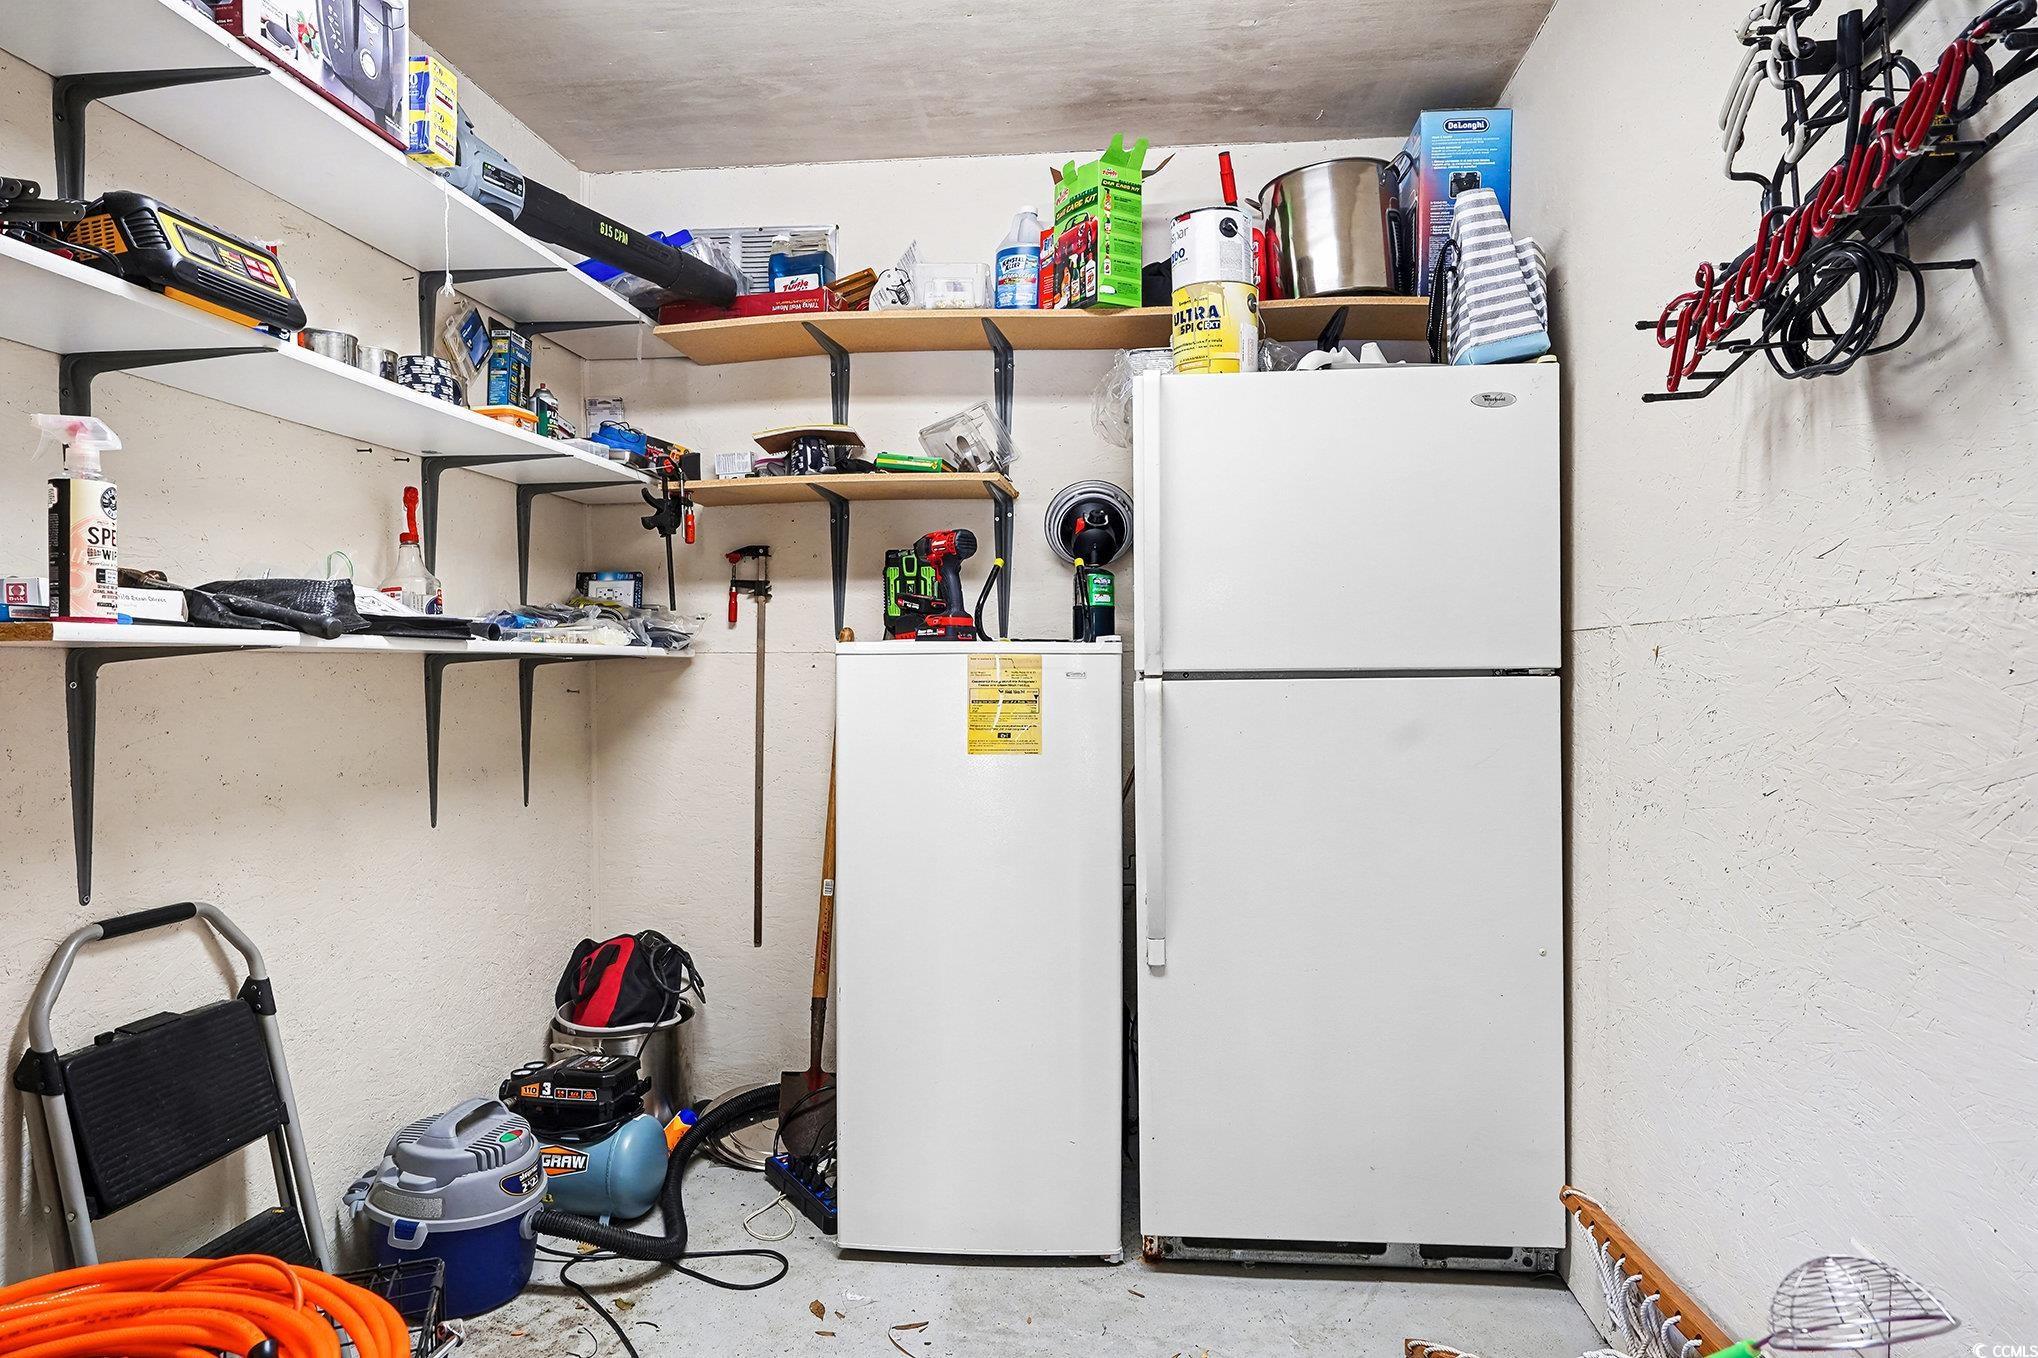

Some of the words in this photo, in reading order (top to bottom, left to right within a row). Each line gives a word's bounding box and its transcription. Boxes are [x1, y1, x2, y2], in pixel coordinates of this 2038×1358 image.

[600, 221, 613, 238] 615
[614, 228, 629, 245] CFM
[1173, 304, 1220, 327] ULTRA
[541, 1081, 552, 1096] 3
